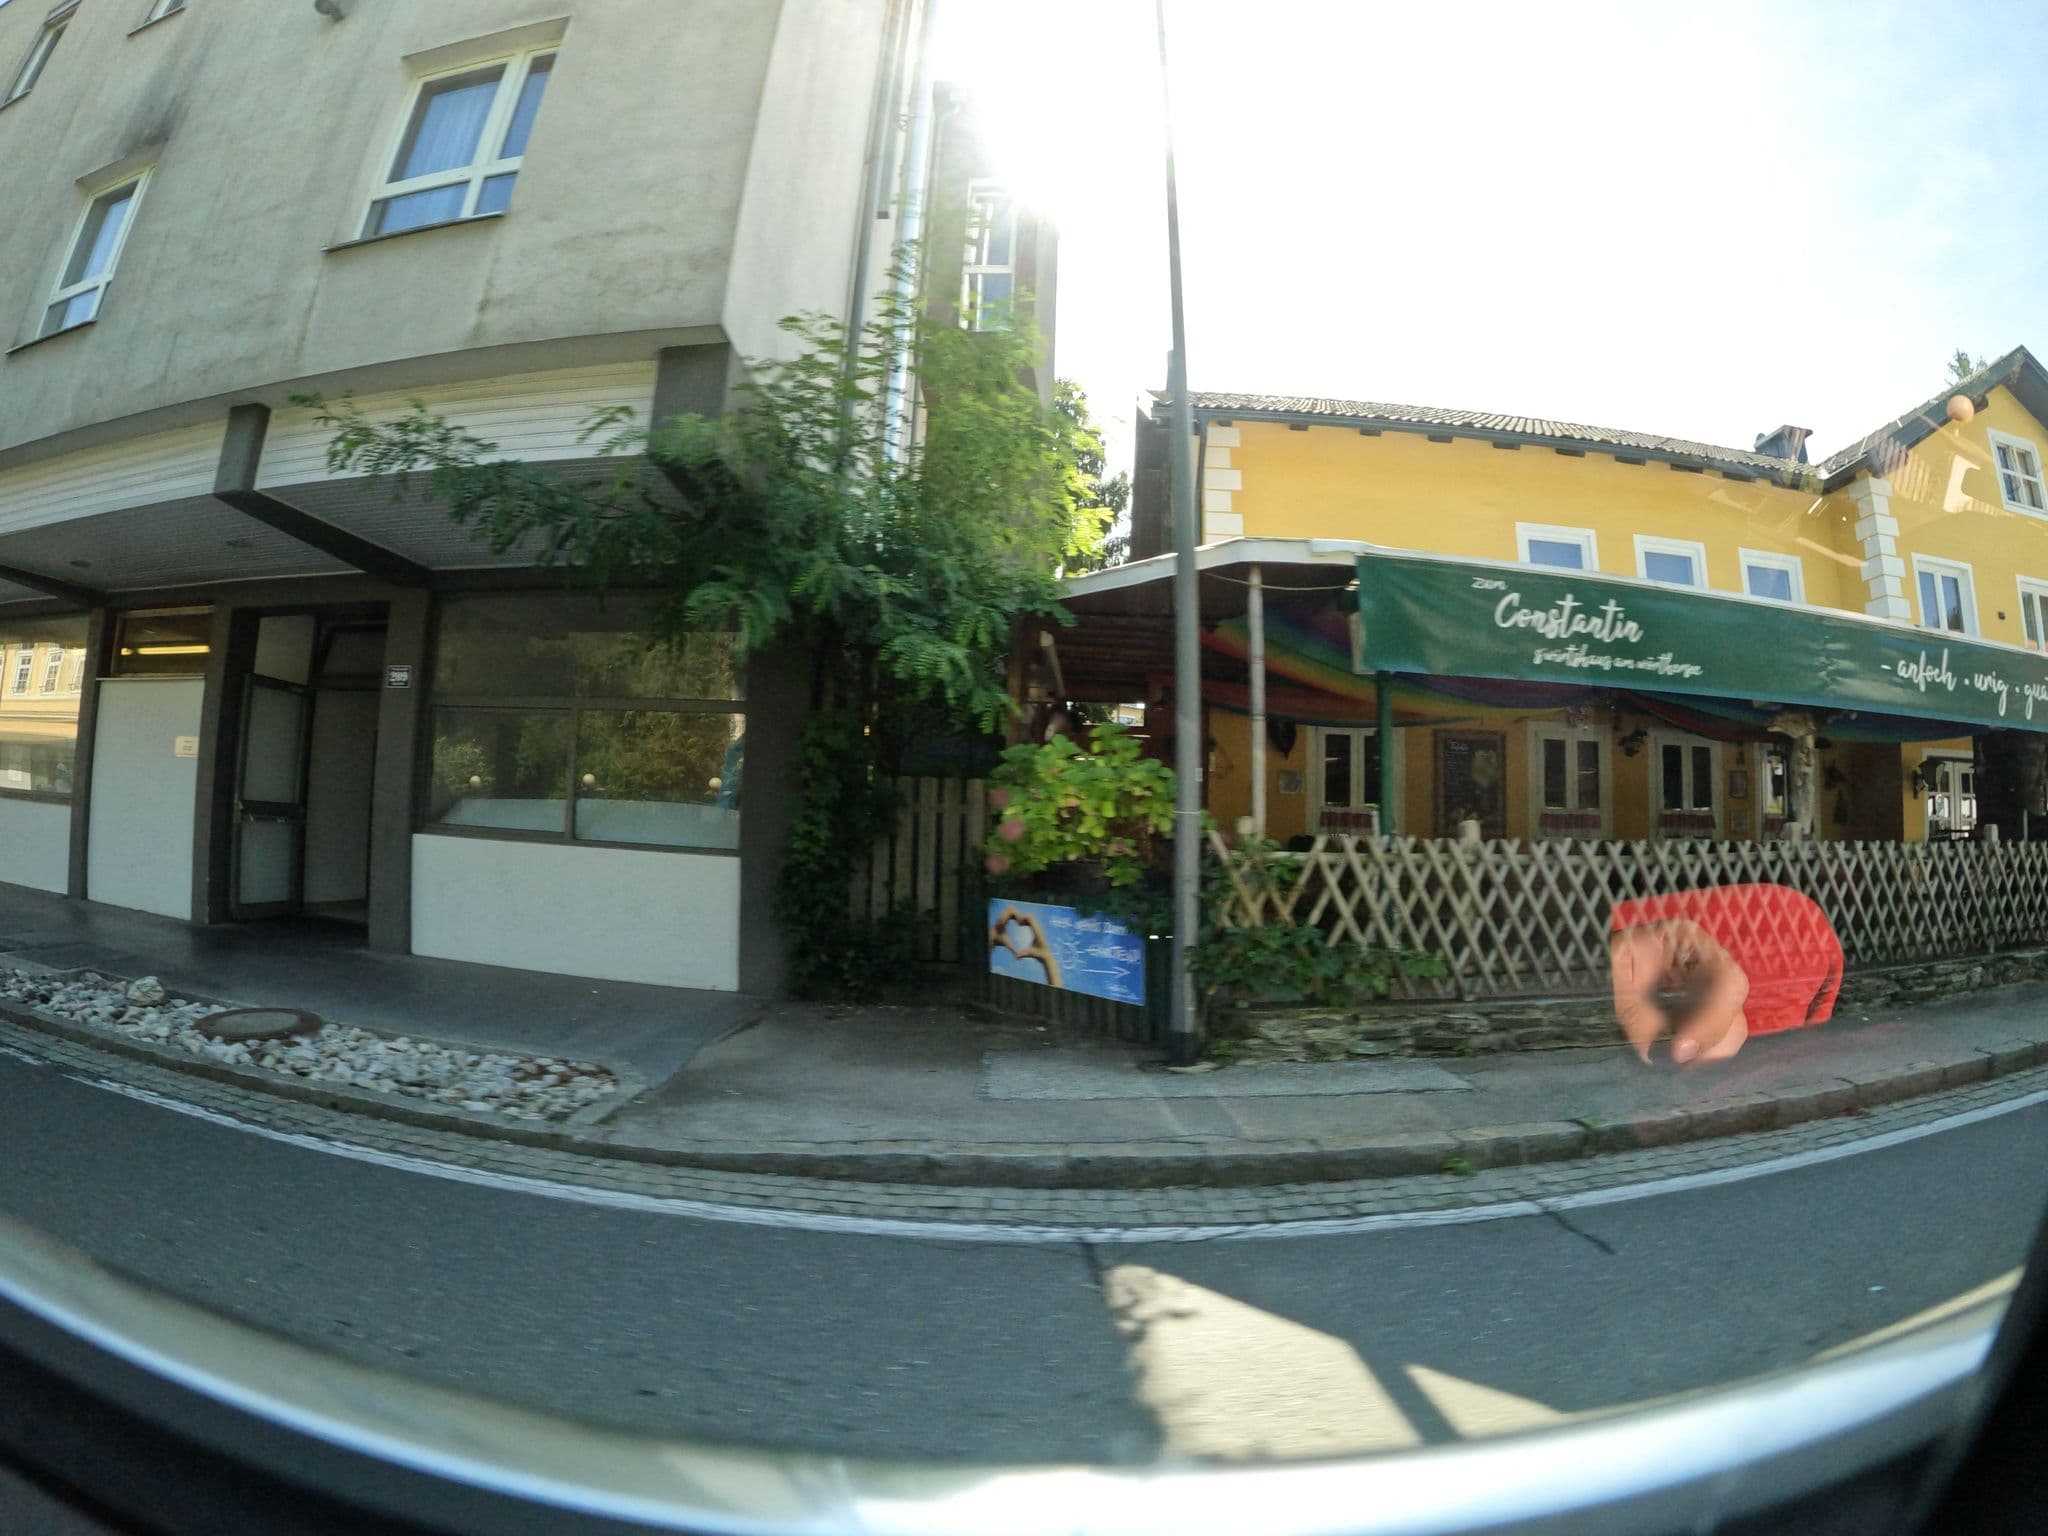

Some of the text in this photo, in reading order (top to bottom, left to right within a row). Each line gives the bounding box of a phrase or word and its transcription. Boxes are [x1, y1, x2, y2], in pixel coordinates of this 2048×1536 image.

[1494, 592, 1644, 643] Constantin
[1973, 671, 2009, 717] urig
[2023, 676, 2048, 721] gua
